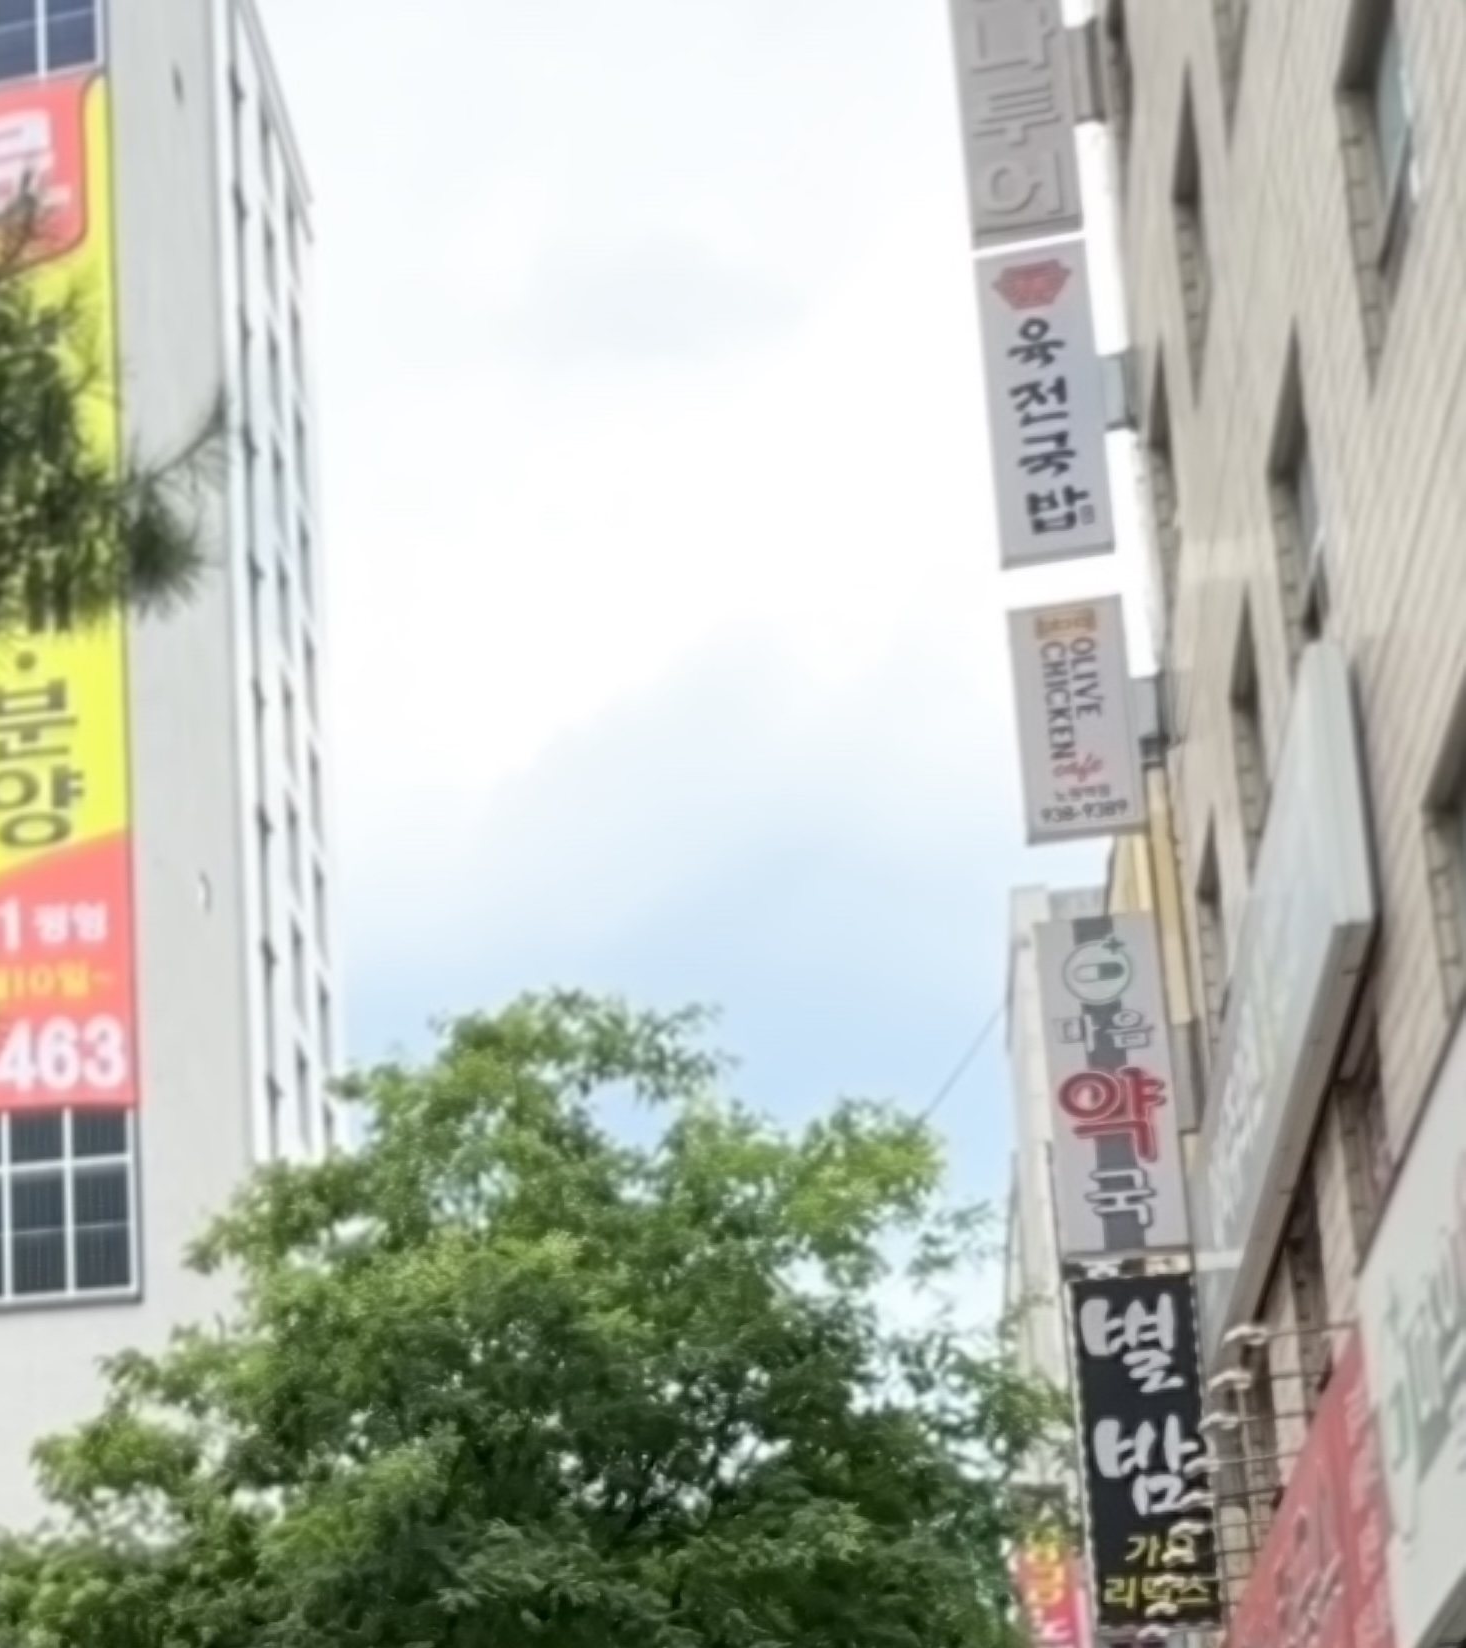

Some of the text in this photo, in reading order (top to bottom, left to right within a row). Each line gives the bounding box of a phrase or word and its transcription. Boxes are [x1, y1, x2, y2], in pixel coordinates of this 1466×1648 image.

[1040, 641, 1077, 761] CHICKEN
[1070, 636, 1104, 720] OLIVE
[1058, 1066, 1167, 1229] 약국
[1080, 1292, 1199, 1516] 별밤
